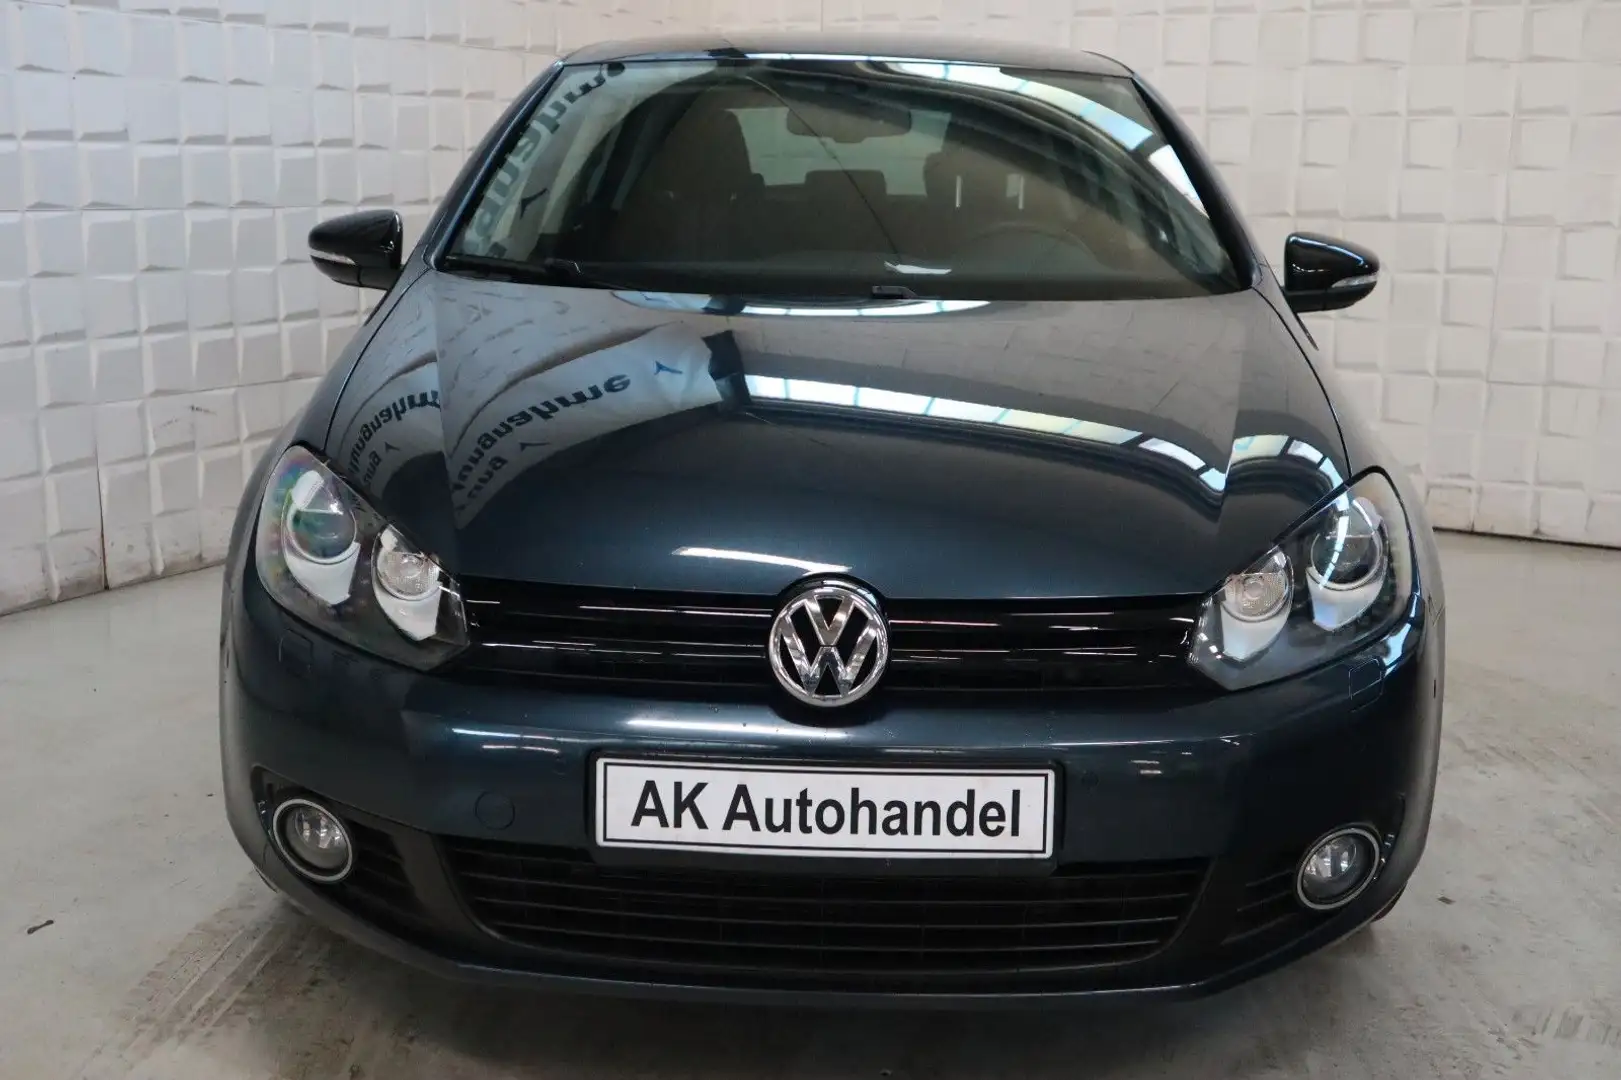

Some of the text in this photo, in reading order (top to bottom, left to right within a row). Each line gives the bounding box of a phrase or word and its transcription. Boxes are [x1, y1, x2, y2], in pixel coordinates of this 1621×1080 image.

[769, 587, 888, 707] VW
[630, 780, 1021, 837] AK Autohandel
